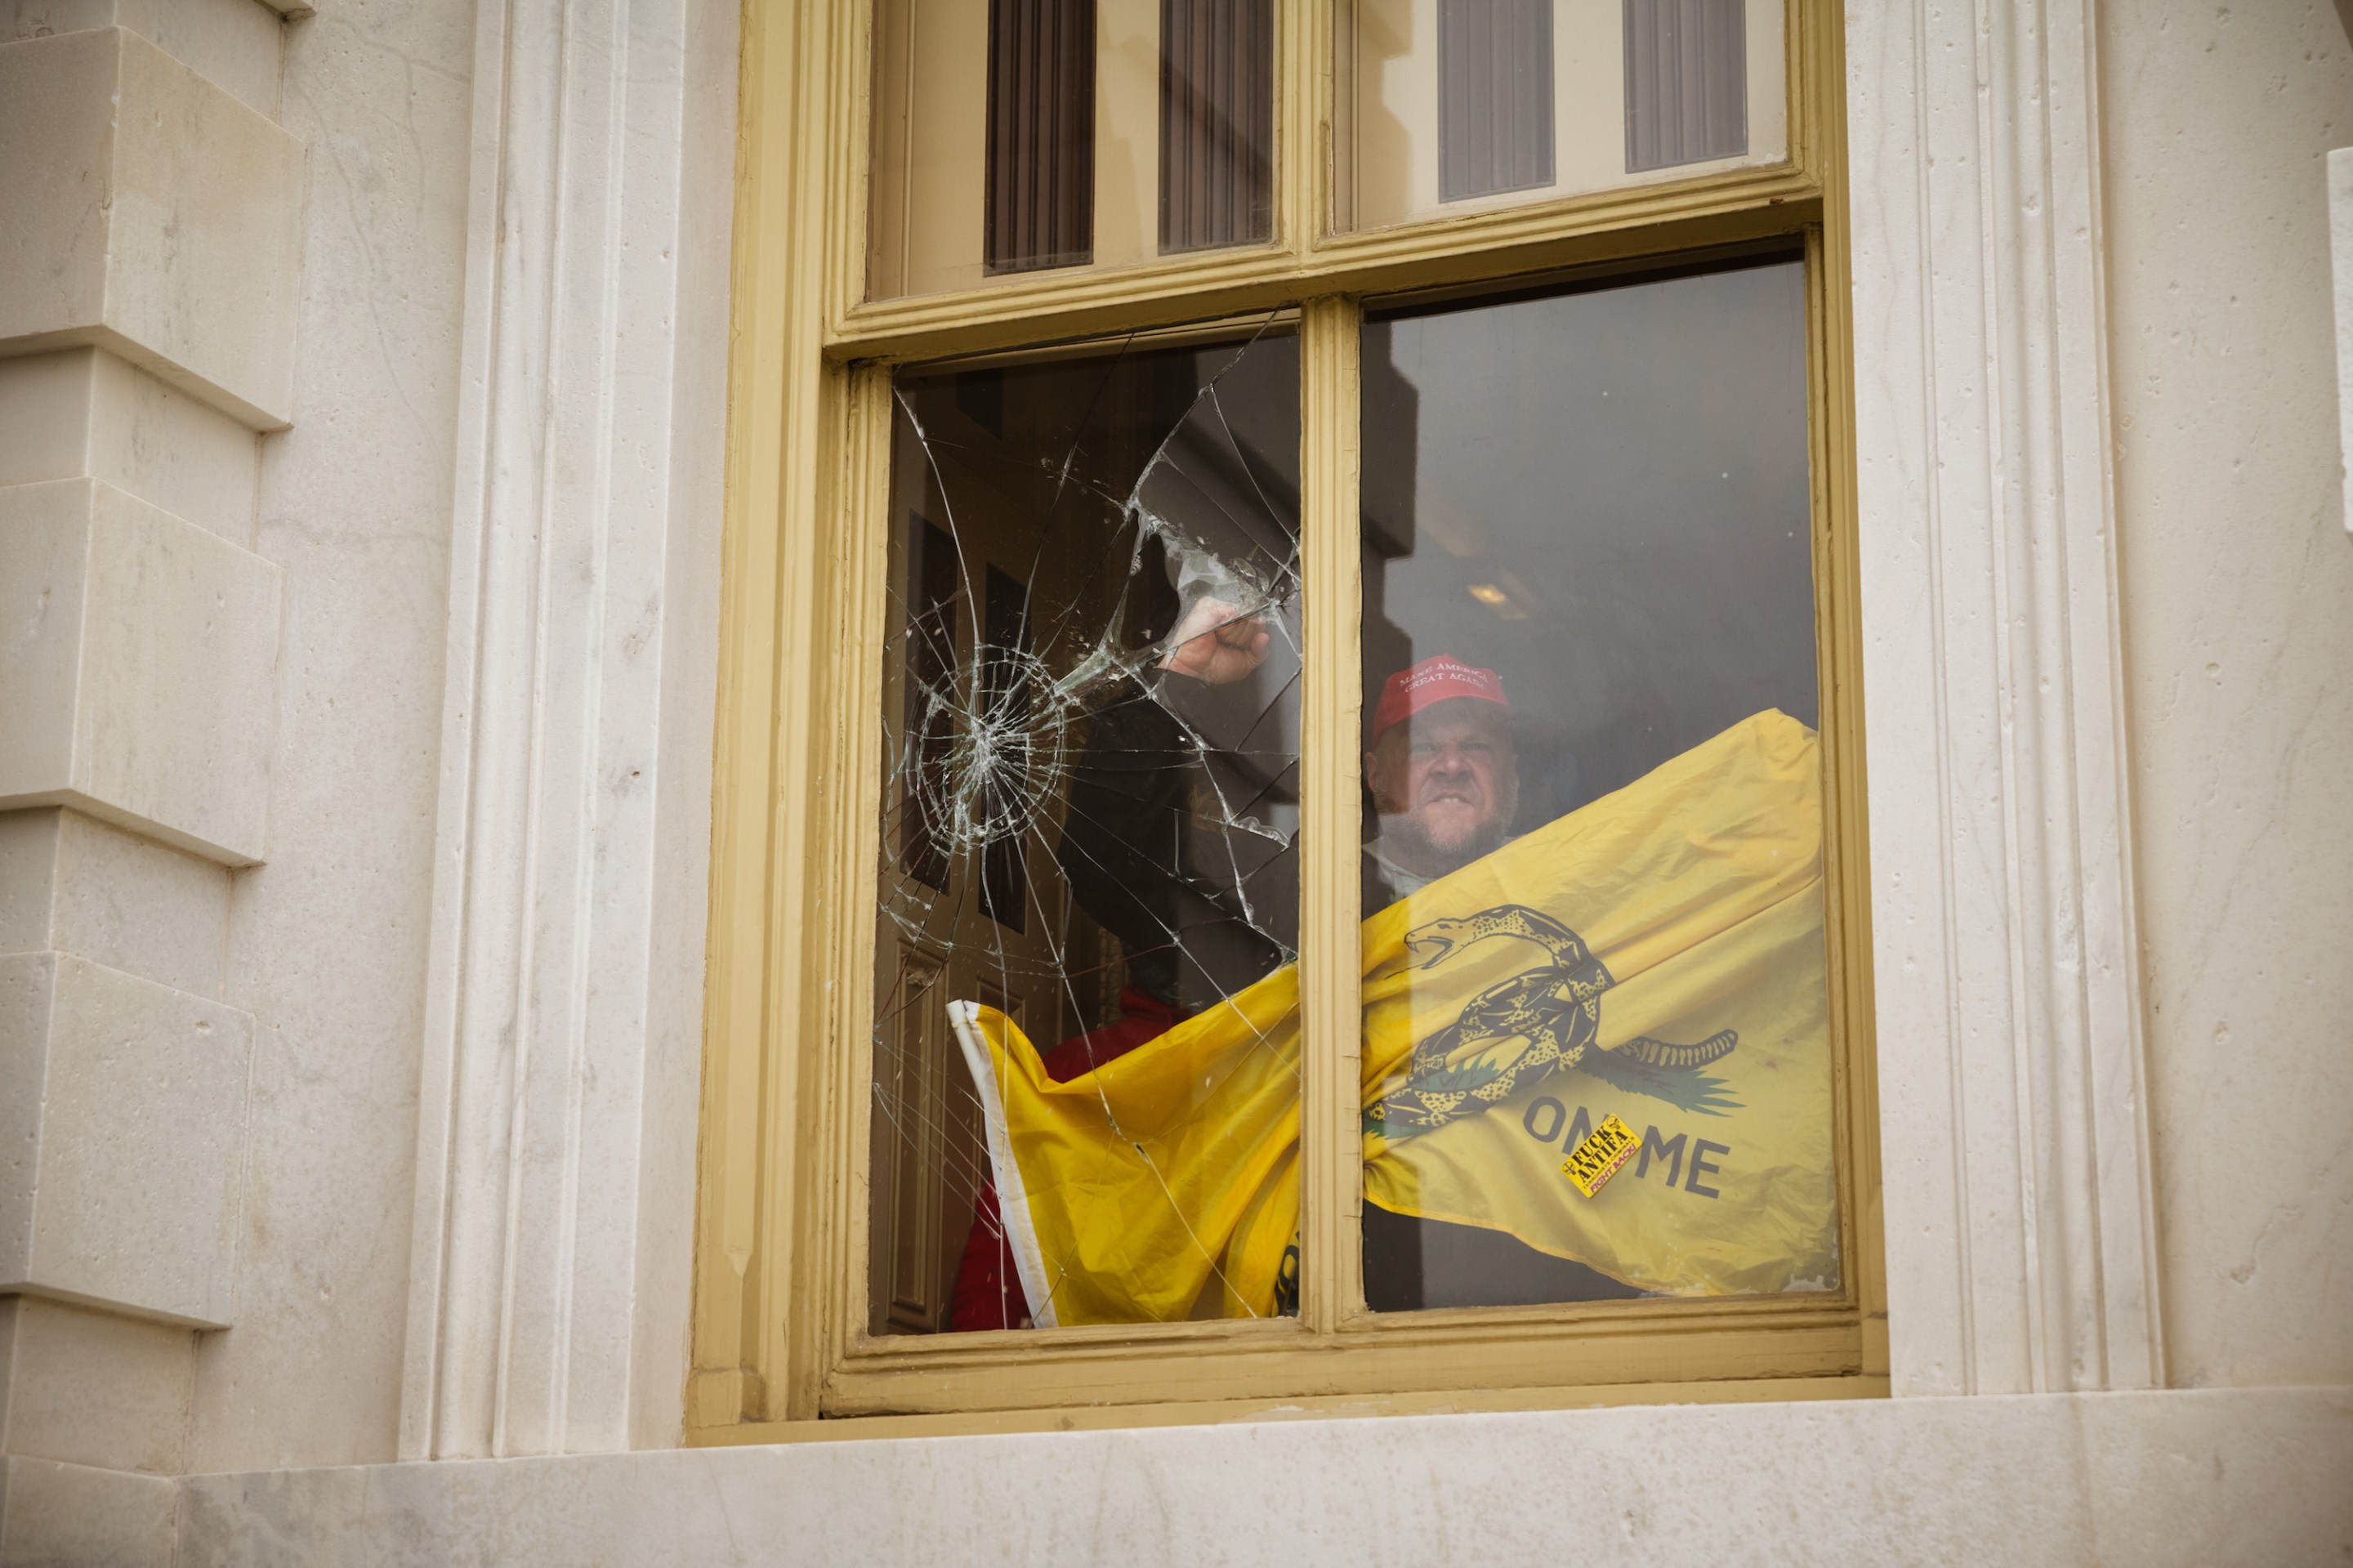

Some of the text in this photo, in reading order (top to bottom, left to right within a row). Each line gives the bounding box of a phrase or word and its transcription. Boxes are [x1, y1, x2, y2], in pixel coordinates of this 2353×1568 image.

[1400, 663, 1489, 687] MAKE AMERICA
[1404, 672, 1485, 693] GREAT AGAIN
[1572, 1125, 1612, 1166] FUCK
[1578, 1131, 1627, 1183] ANTIFA
[1590, 1143, 1636, 1193] FIGHT BACK!
[1635, 1125, 1730, 1199] ME
